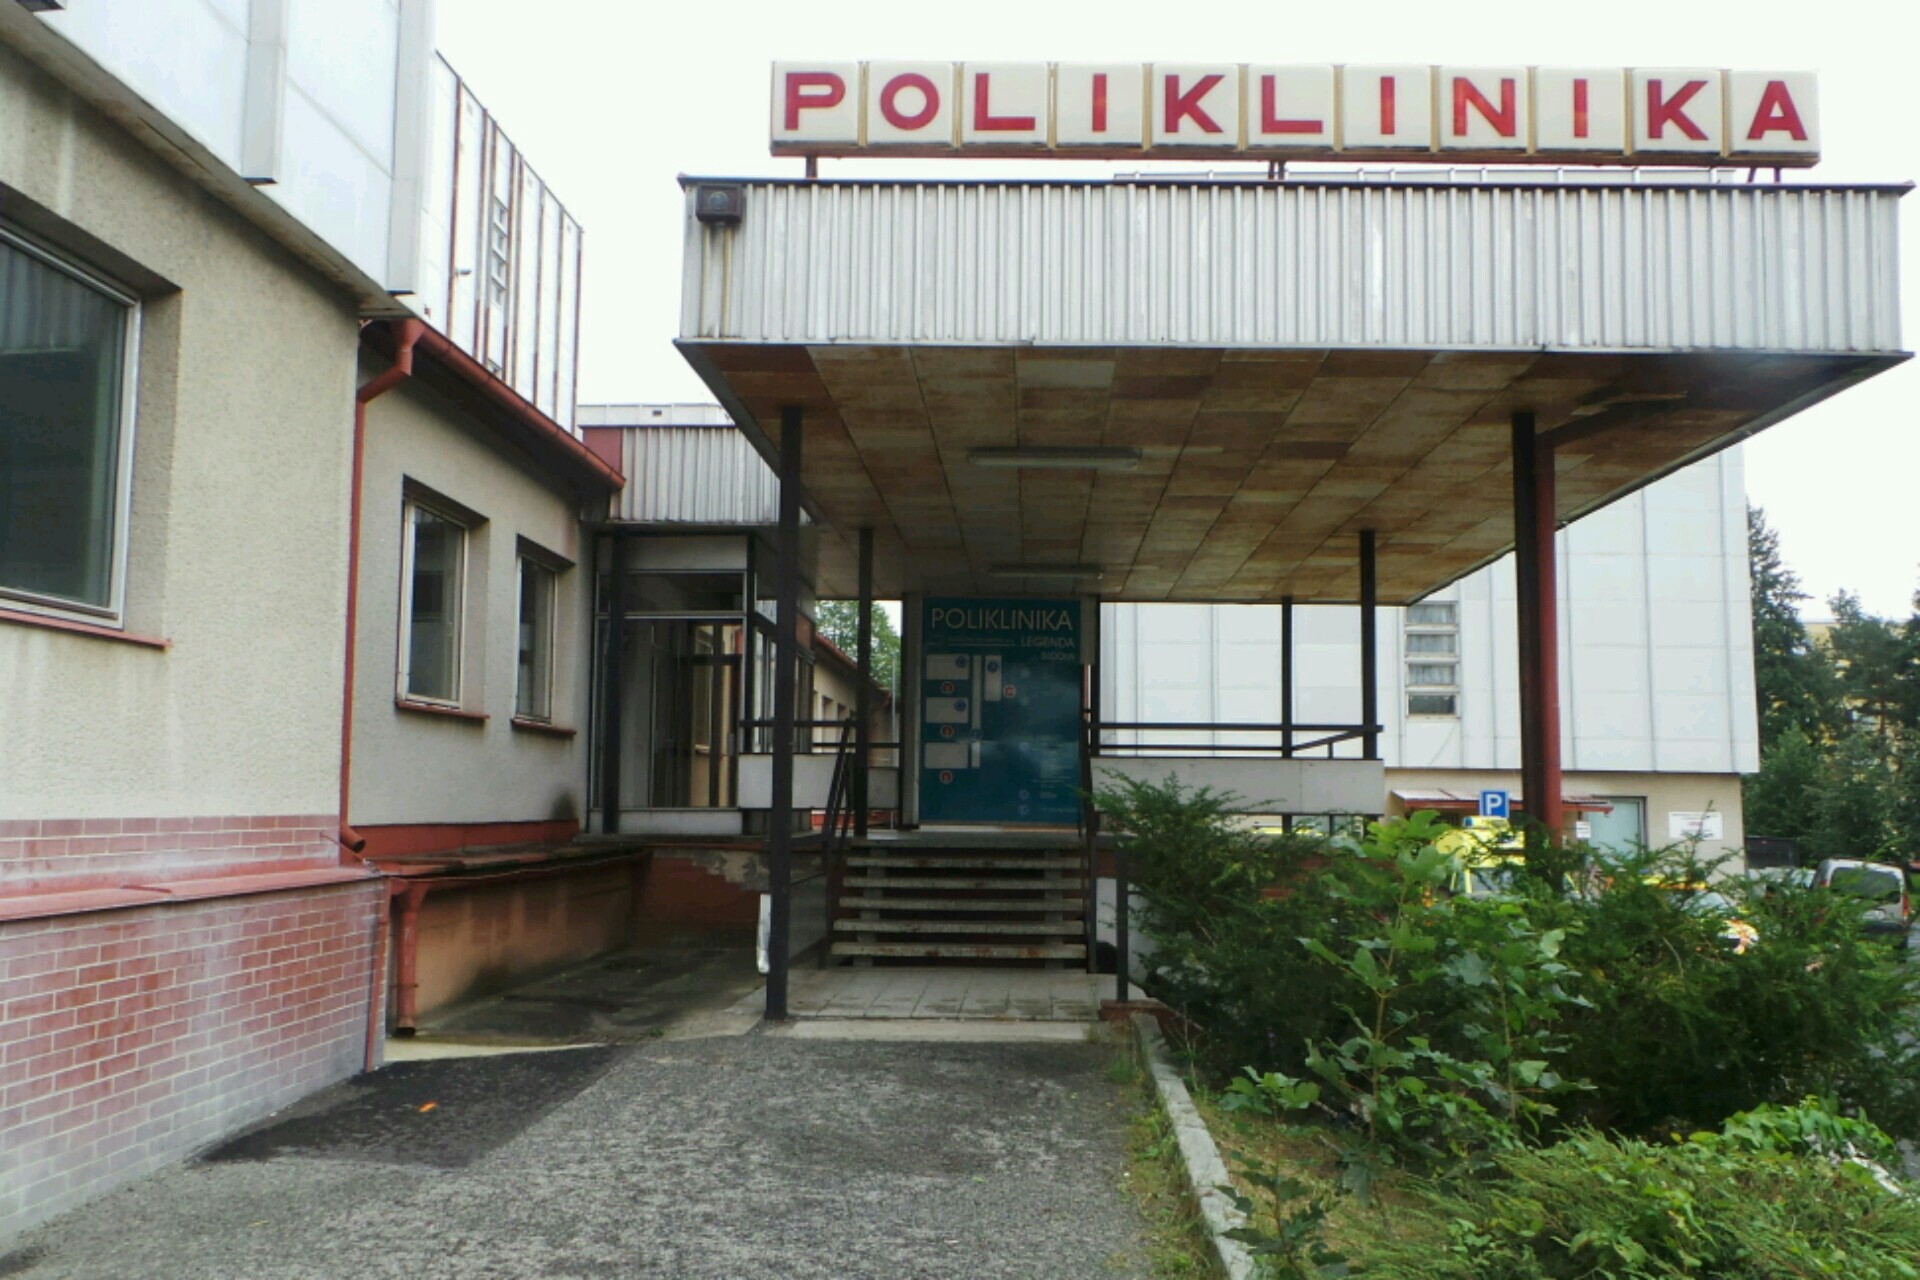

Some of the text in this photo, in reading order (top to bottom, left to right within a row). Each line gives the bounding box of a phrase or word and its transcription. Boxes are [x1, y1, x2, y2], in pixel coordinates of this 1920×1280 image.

[785, 73, 1805, 140] POLIKLINIKA
[931, 607, 1074, 631] POLIKLINIKA
[1021, 636, 1075, 648] LEGENDA
[1485, 794, 1501, 813] P
